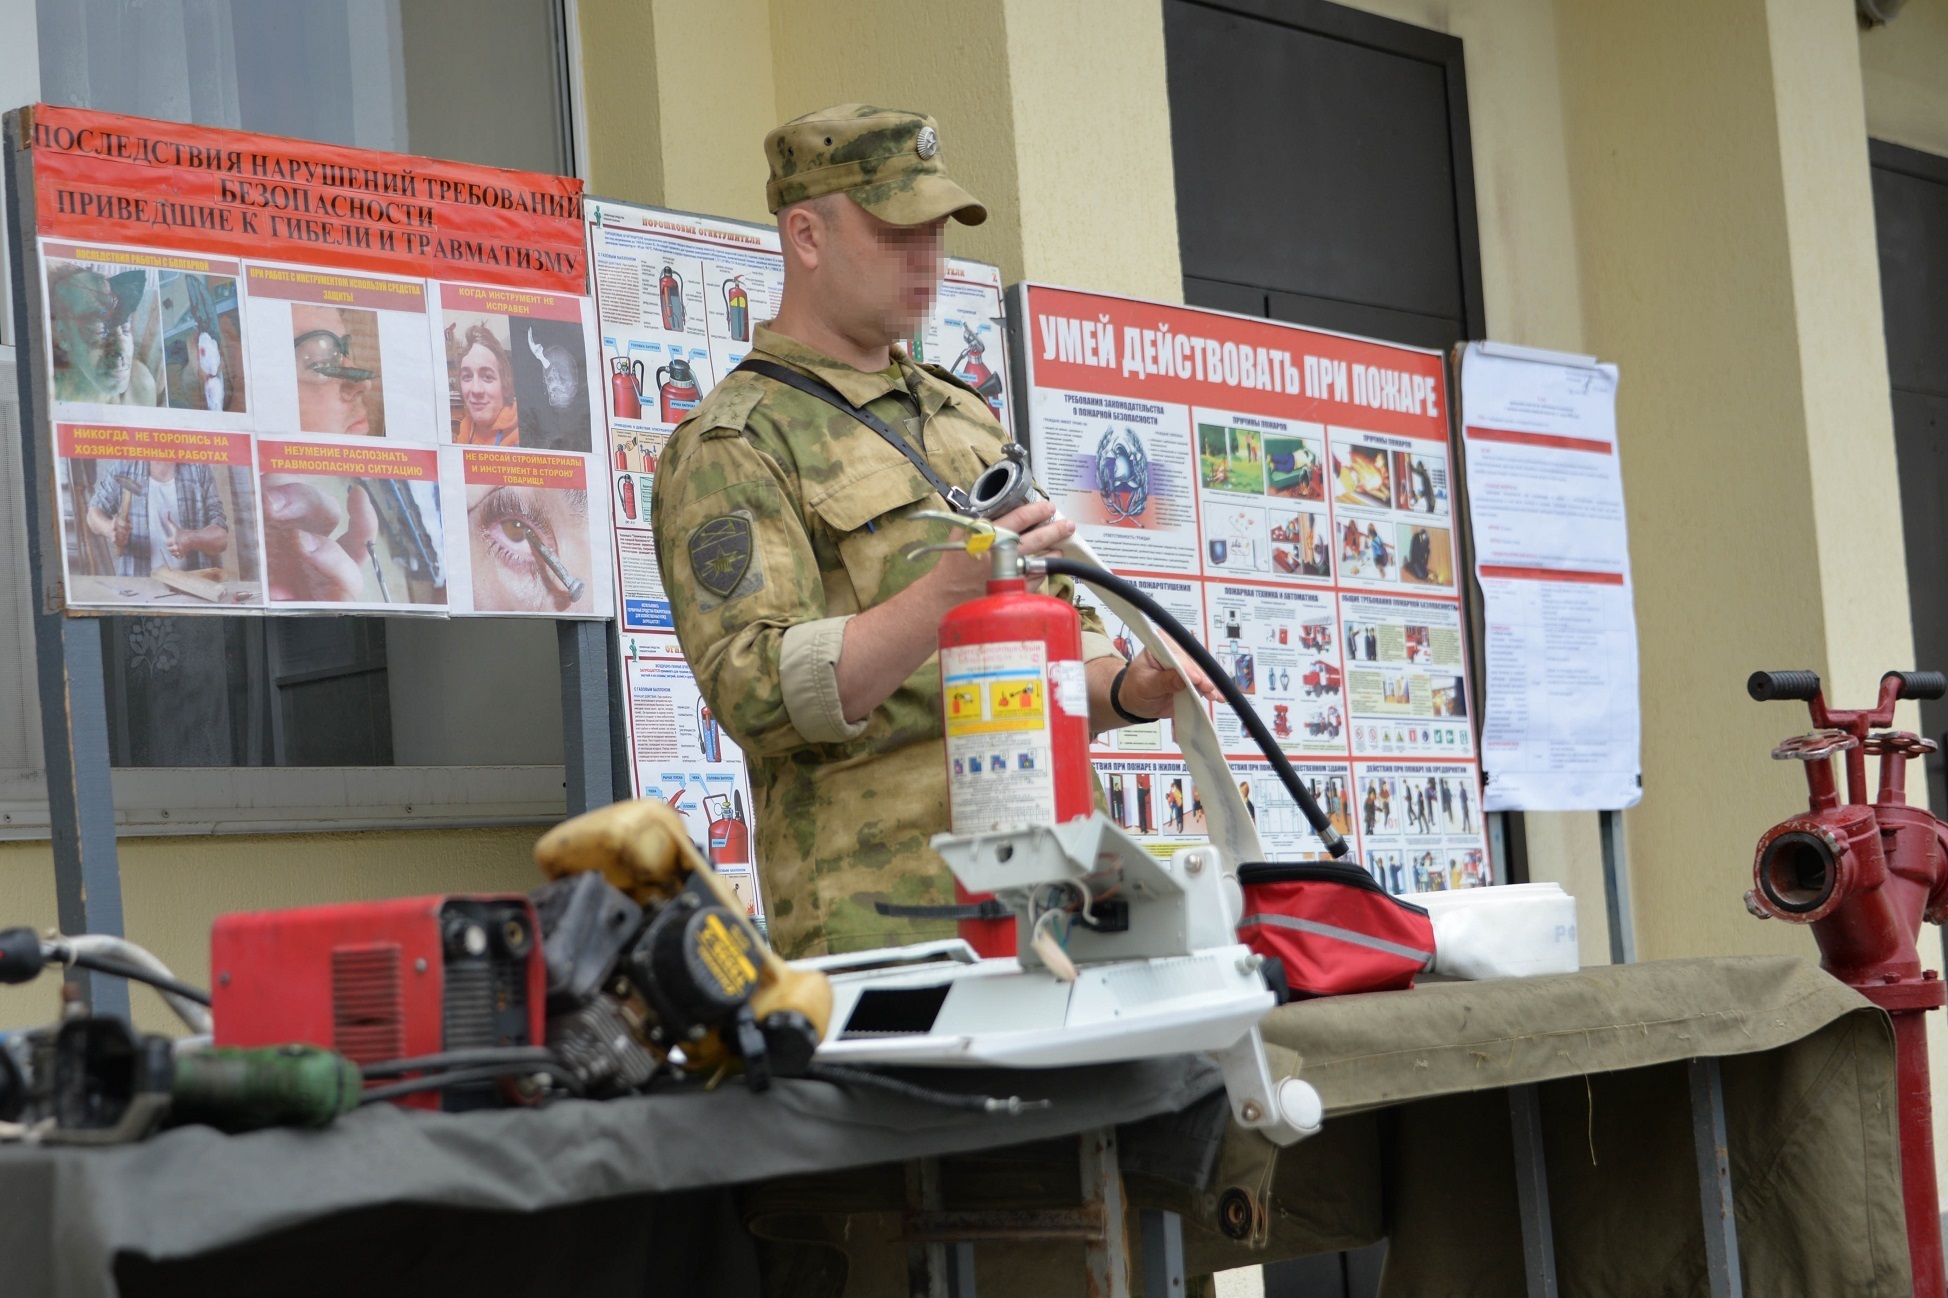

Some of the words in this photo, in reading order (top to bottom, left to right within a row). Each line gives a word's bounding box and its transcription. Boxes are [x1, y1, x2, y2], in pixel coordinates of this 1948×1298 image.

[35, 122, 241, 174] ПОСЛЕДСТВИЯ
[252, 153, 416, 198] НАРУШЕНИЙ
[423, 177, 583, 220] ТРЕБОВАНИЙ
[220, 178, 434, 228] БЕЗОПАСНОСТИ
[57, 189, 233, 232] ПРИВЕДШИЕ
[240, 212, 258, 235] К
[271, 215, 372, 249] ГИБЕЛИ
[377, 229, 396, 252] И
[403, 232, 577, 275] ТРАВМАТИЗМУ
[642, 217, 696, 235] ПОРОШКОВЫЕ
[699, 228, 761, 245] ОГНЕТУШИТЕЛИ
[76, 248, 130, 262] ПОСЛЕДСТВИЯ
[132, 254, 161, 266] РАБОТЫ
[163, 258, 167, 266] С
[169, 258, 209, 271] БОЛГАРКОЙ
[250, 268, 264, 278] ПРИ
[265, 270, 289, 281] РАБОТЕ
[291, 273, 295, 281] С
[297, 273, 348, 287] ИНСТРУМЕНТОМ
[350, 278, 386, 291] ИСПОЛЬЗУЙ
[388, 284, 421, 295] СРЕДСТВА
[323, 290, 354, 302] ЗАЩИТЫ
[459, 288, 486, 298] КОГДА
[489, 290, 541, 304] ИНСТРУМЕНТ
[486, 302, 529, 314] ИСПРАВЕН
[1039, 314, 1117, 368] УМЕЙ
[1122, 322, 1299, 395] ДЕЙСТВОВАТЬ
[1304, 355, 1347, 402] ПРИ
[1352, 363, 1438, 418] ПОЖАРЕ
[1064, 394, 1103, 406] ТРЕБОВАНИЯ
[1104, 399, 1164, 414] ЗАКОНОДАТЕЛЬСТВА
[1079, 408, 1112, 420] ПОЖАРНОЙ
[1113, 412, 1158, 425] БЕЗОПАСНОСТИ
[1233, 416, 1260, 427] ПРИЧИНЫ
[1261, 420, 1287, 431] ПОЖАРОВ
[73, 429, 129, 441] НИКОГДА
[135, 432, 150, 442] НЕ
[153, 432, 210, 446] ТОРОПИСЬ
[214, 436, 229, 446] НА
[1363, 434, 1387, 444] ПРИЧИНЫ
[1388, 438, 1412, 448] ПОЖАРОВ
[75, 444, 176, 458] ХОЗЯЙСТВЕННЫХ
[179, 449, 229, 461] РАБОТАХ
[284, 446, 340, 458] НЕУМЕНИЕ
[343, 449, 408, 462] РАСПОЗНАТЬ
[479, 453, 510, 462] БРОСАЙ
[513, 455, 582, 466] СТРОЙМАТЕРИАЛЫ
[270, 458, 365, 473] ТРАВМООПАСНУЮ
[368, 463, 422, 476] СИТУАЦИЮ
[481, 465, 530, 475] ИНСТРУМЕНТ
[540, 469, 573, 478] СТОРОНУ
[503, 476, 544, 485] ТОВАРИЩА
[1139, 582, 1191, 592] ПОЖАРОТУШЕНИЯ
[1225, 587, 1254, 597] ПОЖАРНАЯ
[1255, 590, 1278, 599] ТЕХНИКА
[1284, 592, 1318, 602] АВТОМАТИКА
[1341, 594, 1360, 603] ОБЩИЕ
[1360, 596, 1392, 605] ТРЕБОВАНИЯ
[1393, 598, 1419, 608] ПОЖАРНОЙ
[1092, 762, 1112, 770] СТВИЯ
[1127, 762, 1151, 771] ПОЖАРЕ
[1158, 763, 1181, 771] ЖИЛОМ
